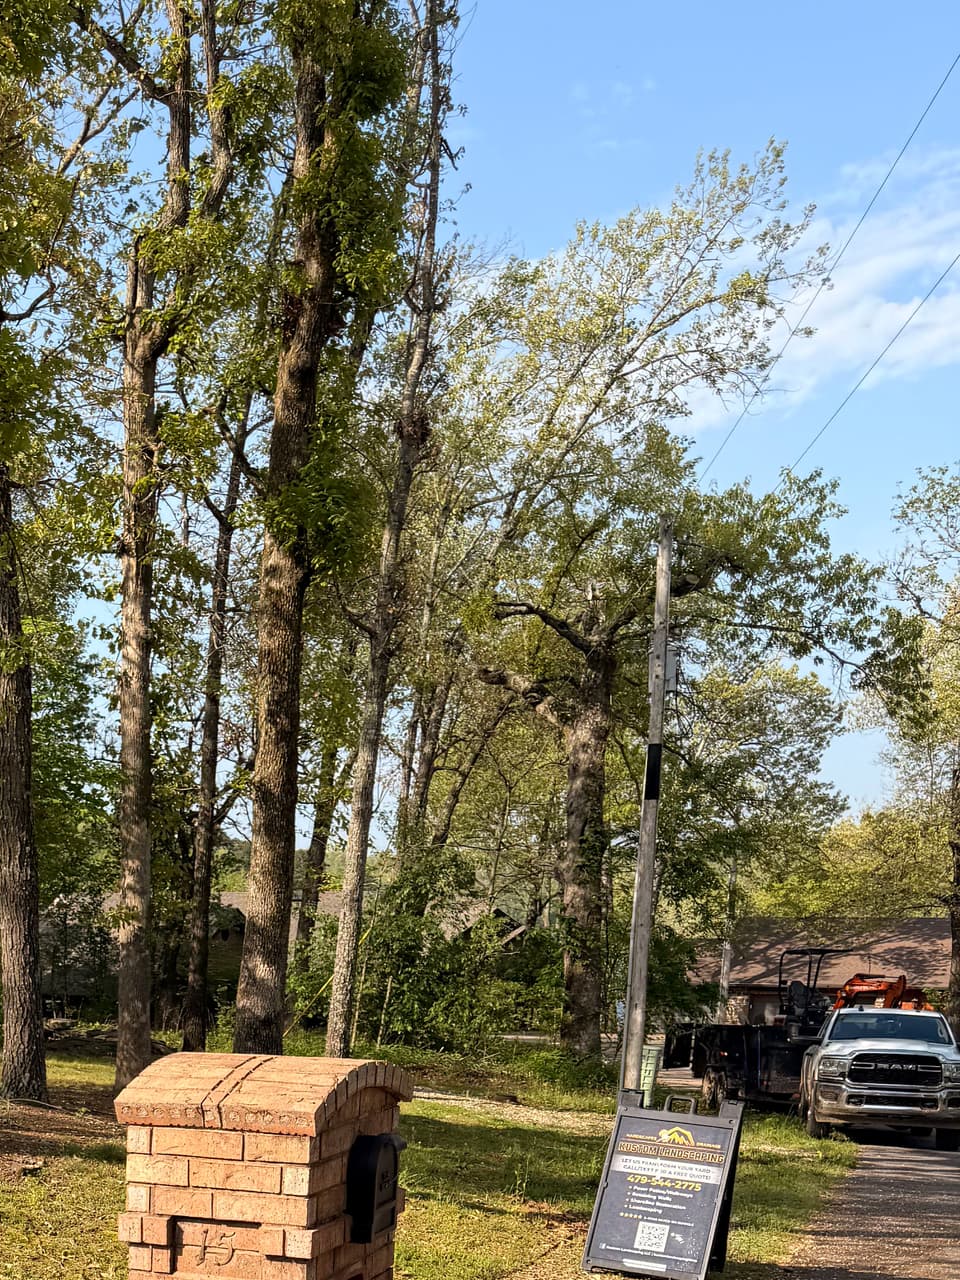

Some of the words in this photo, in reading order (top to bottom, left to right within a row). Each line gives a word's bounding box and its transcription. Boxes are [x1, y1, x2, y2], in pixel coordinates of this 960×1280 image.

[874, 1063, 917, 1071] RAM
[619, 1142, 657, 1154] KUSTOM
[659, 1147, 724, 1163] LANDSCAPING
[627, 1174, 702, 1191] 479-544-2775
